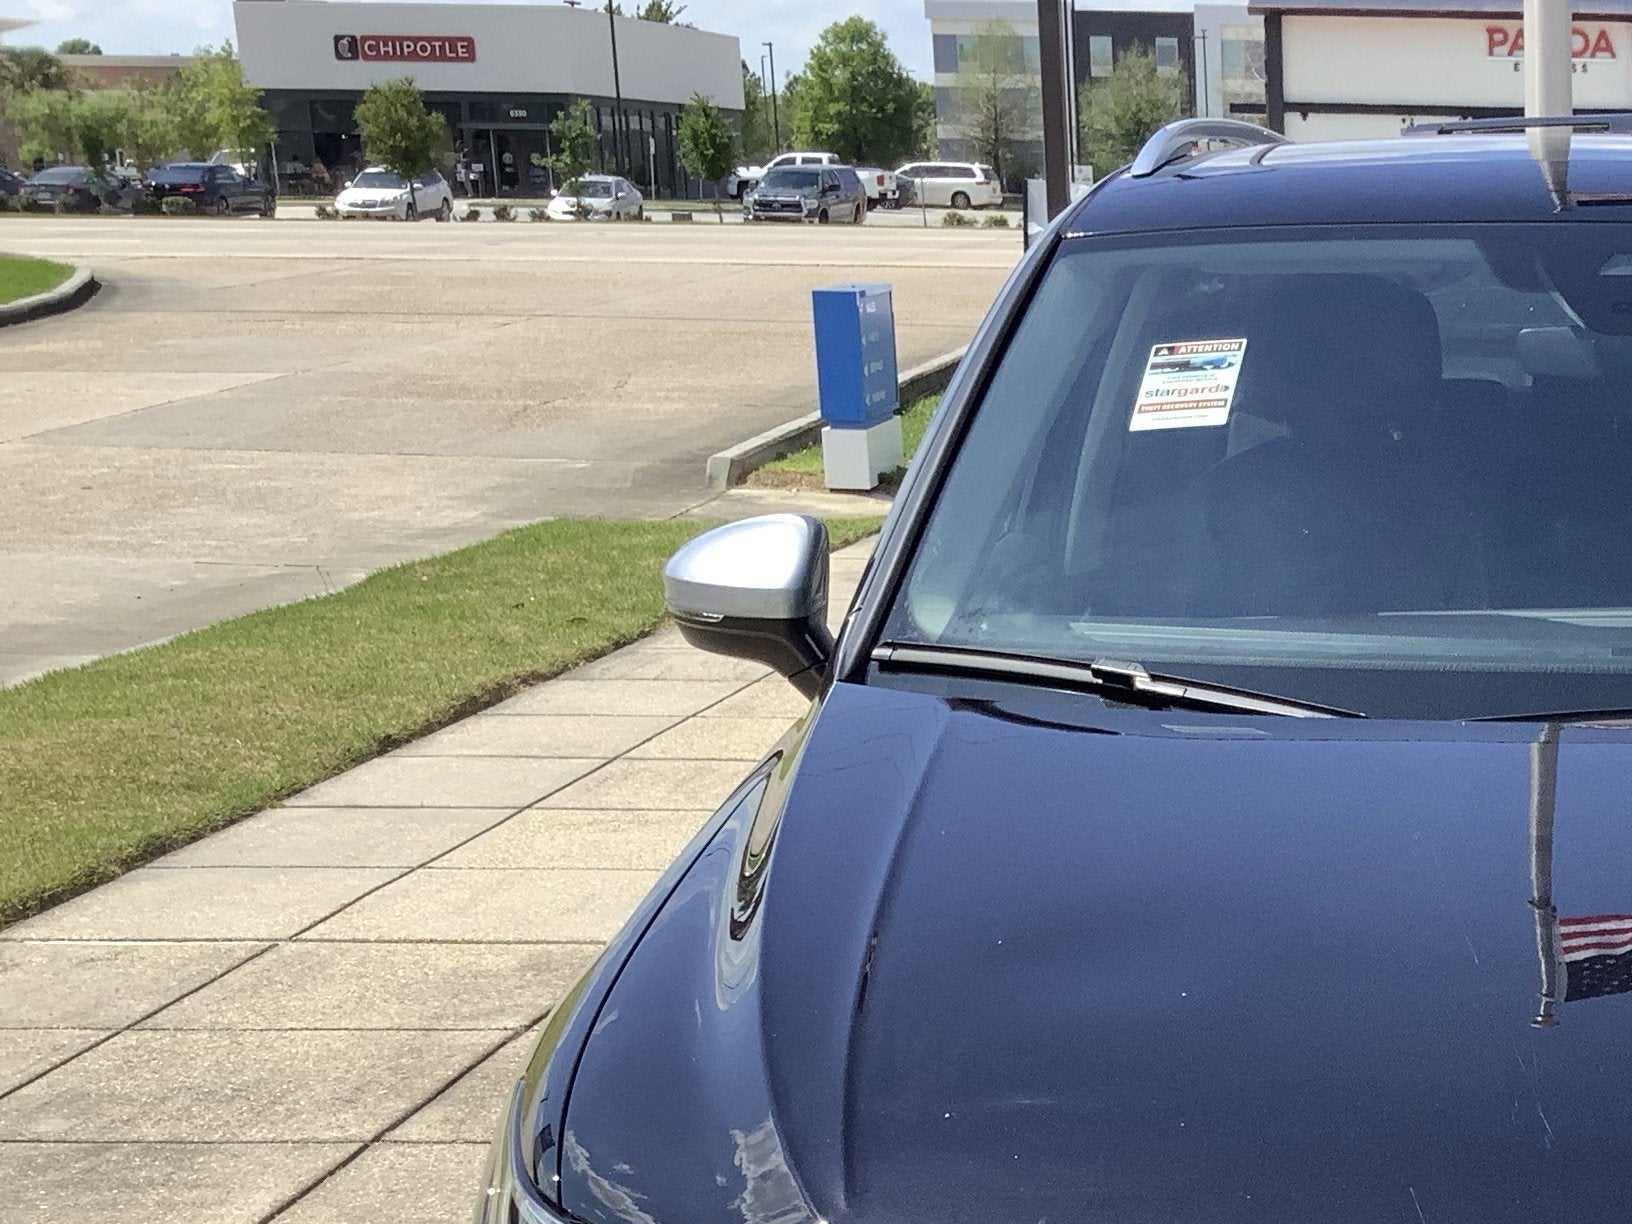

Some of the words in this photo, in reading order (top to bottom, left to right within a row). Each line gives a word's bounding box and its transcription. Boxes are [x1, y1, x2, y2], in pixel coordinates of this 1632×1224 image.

[363, 40, 469, 58] CHIPOTLE
[1486, 26, 1616, 59] PADA
[1179, 343, 1239, 354] ATTENTION
[1199, 400, 1225, 408] SYSTEM
